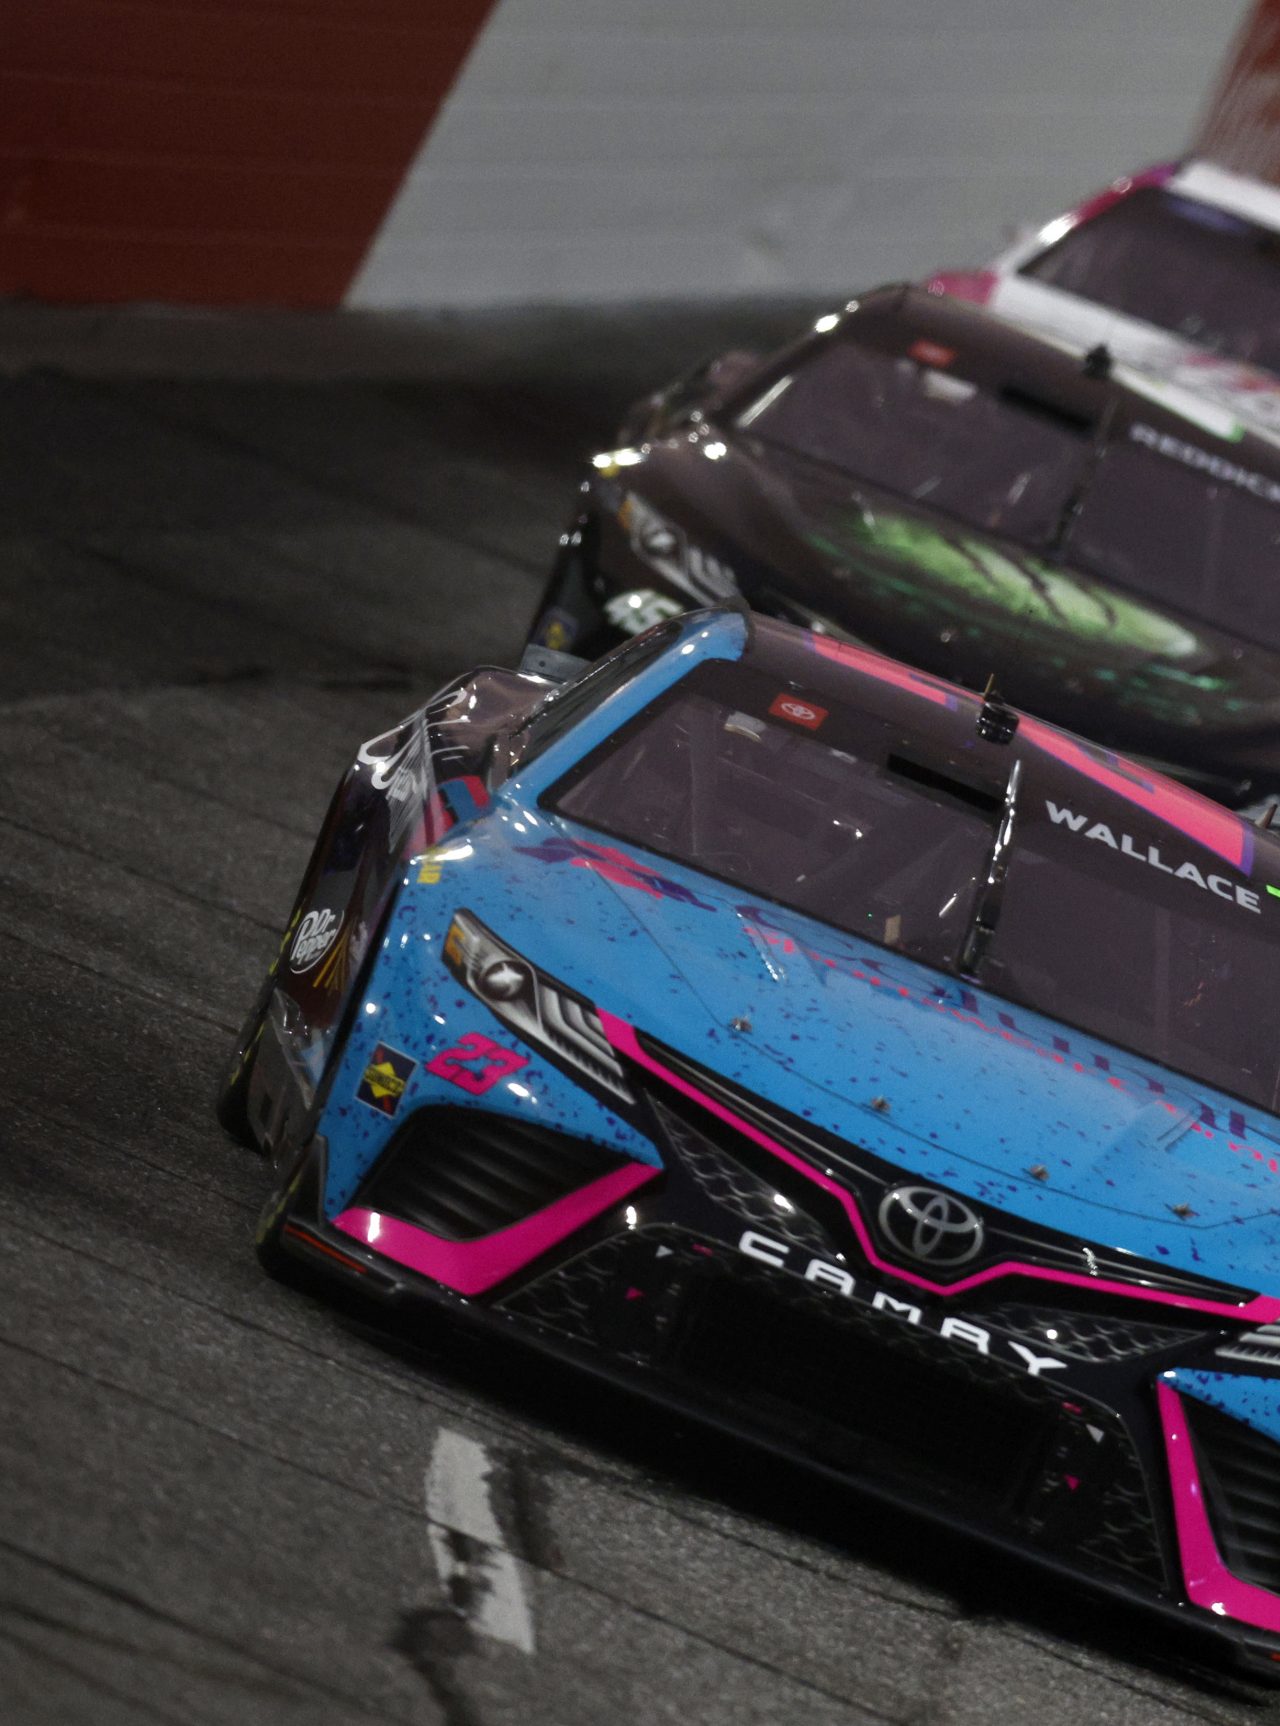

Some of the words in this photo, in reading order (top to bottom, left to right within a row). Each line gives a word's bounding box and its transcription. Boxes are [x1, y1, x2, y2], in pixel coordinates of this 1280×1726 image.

[1045, 799, 1262, 915] WALLACE
[424, 1031, 529, 1096] 23
[738, 1230, 1068, 1376] CAMRY
